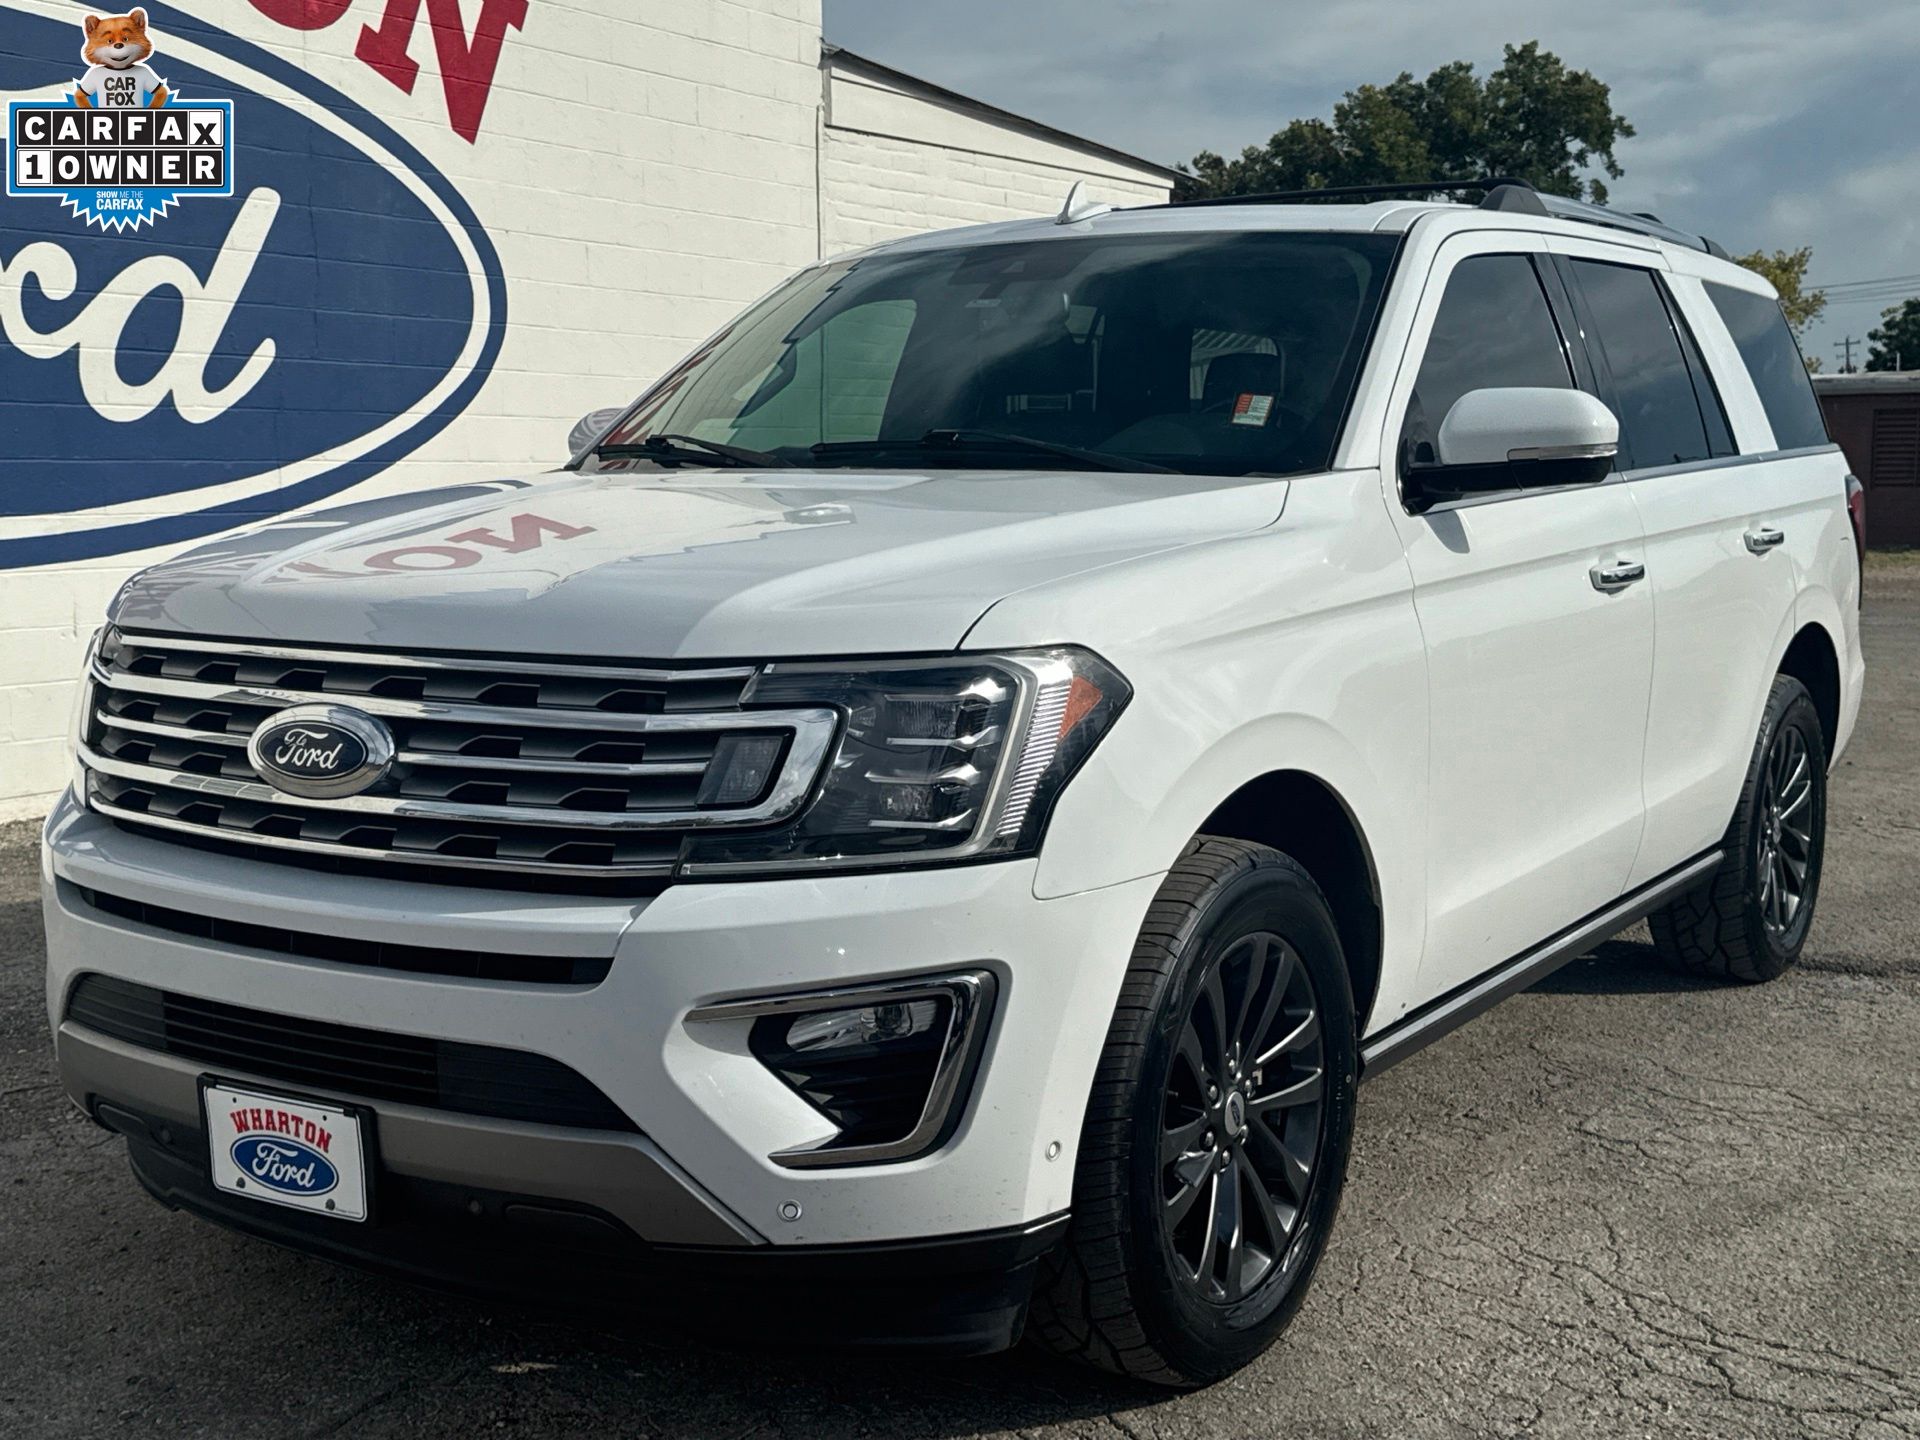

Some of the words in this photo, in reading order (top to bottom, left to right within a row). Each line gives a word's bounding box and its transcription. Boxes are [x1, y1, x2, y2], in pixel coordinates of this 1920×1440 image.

[248, 0, 529, 145] N
[275, 728, 343, 770] Ford
[230, 1108, 333, 1153] WHARTON
[251, 1142, 316, 1188] Ford
